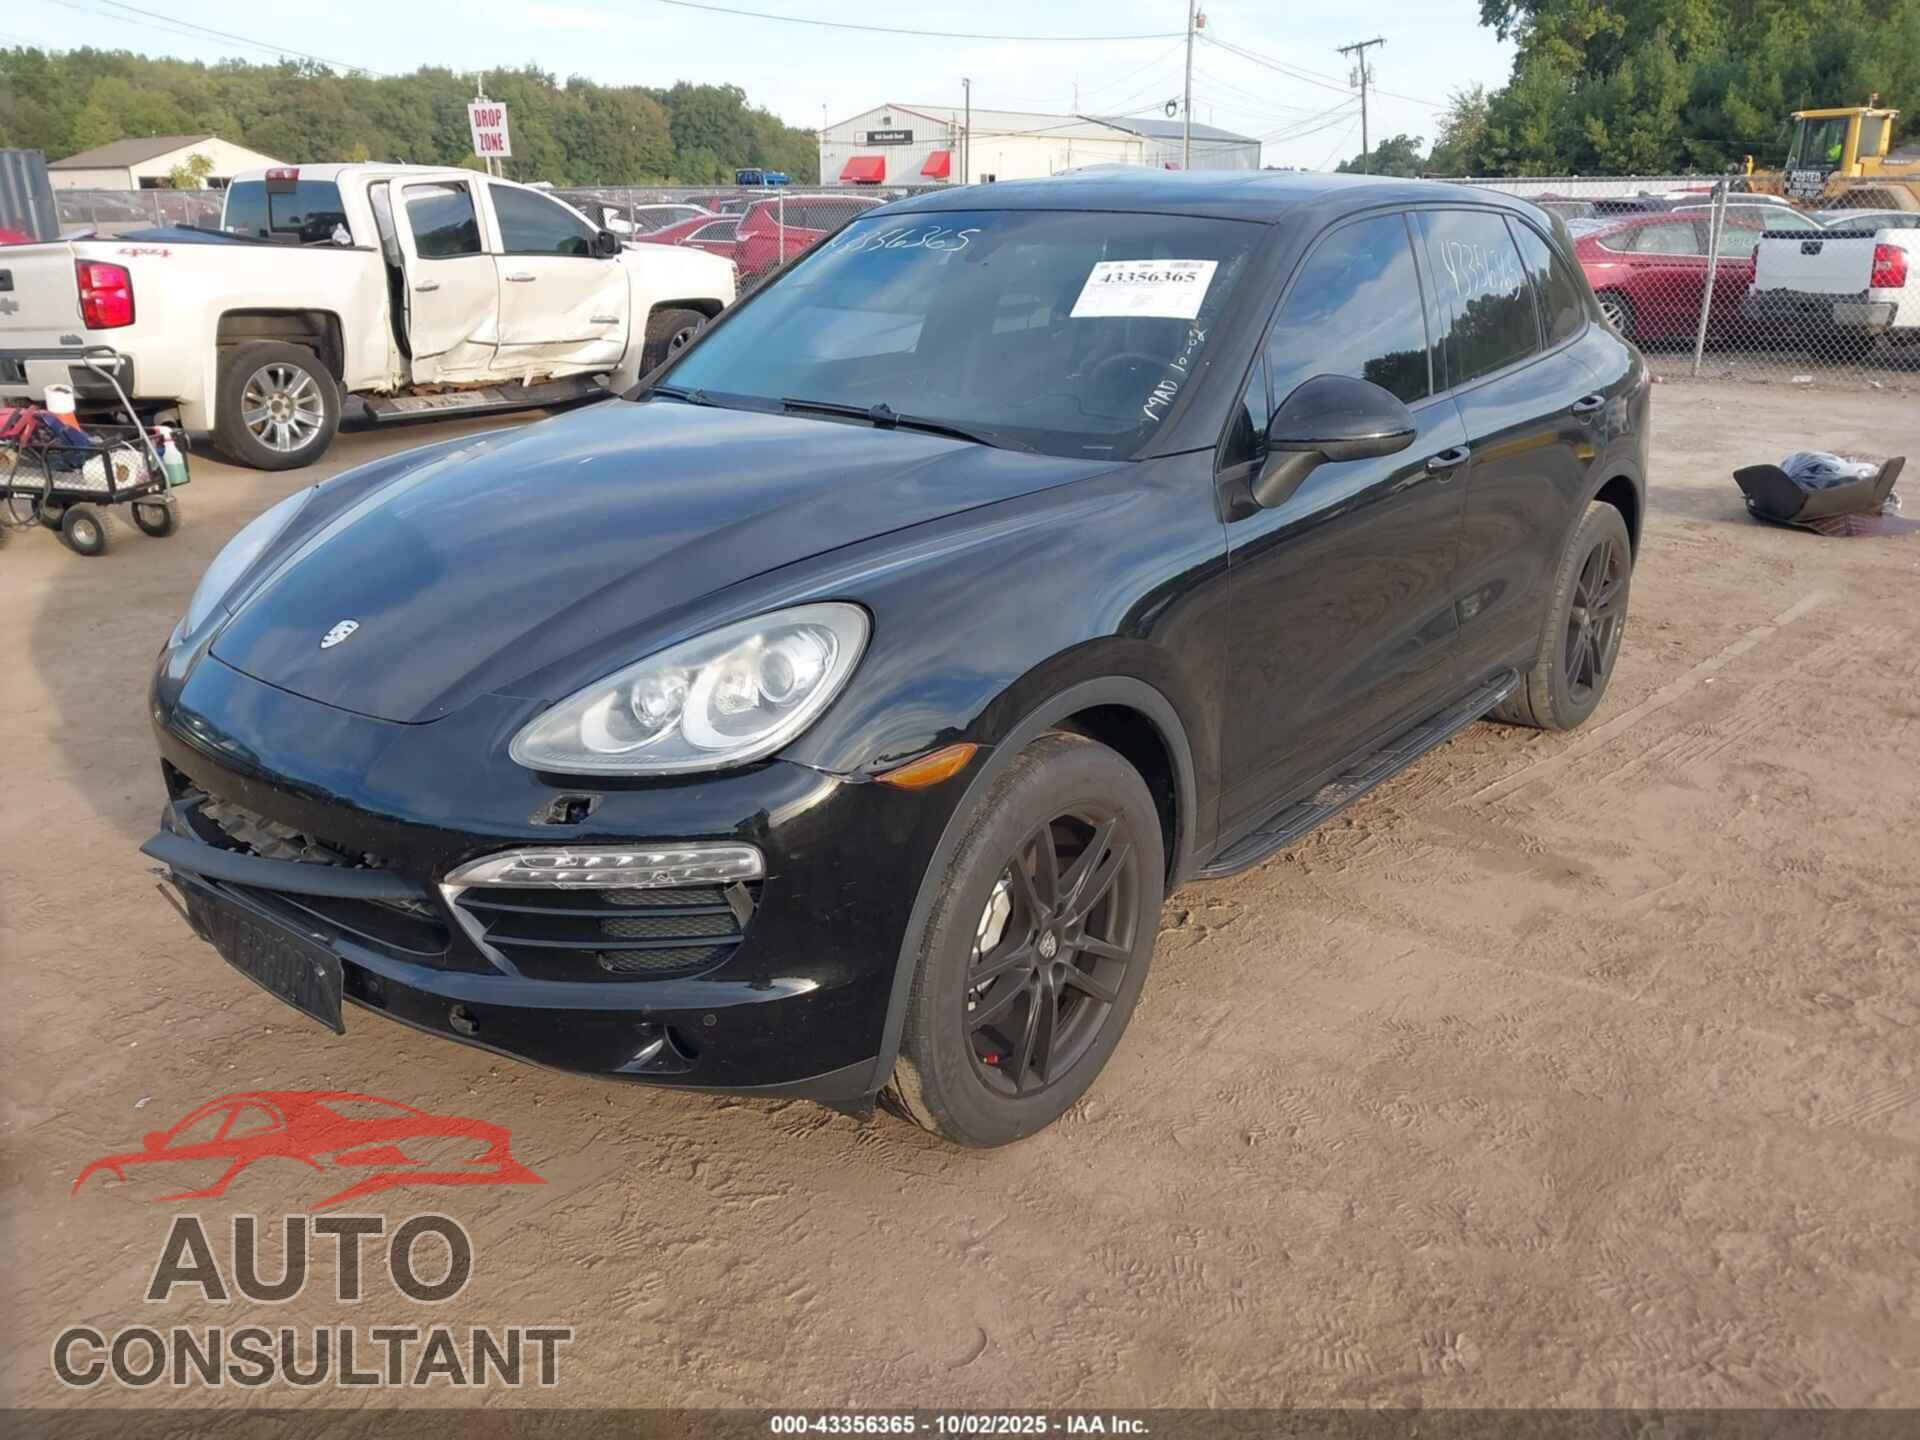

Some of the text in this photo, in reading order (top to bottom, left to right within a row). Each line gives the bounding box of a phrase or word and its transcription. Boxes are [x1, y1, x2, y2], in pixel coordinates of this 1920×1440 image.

[473, 109, 502, 128] DROP
[479, 132, 505, 152] ZONE
[1100, 271, 1199, 284] 43356365
[1143, 379, 1179, 422] MAD
